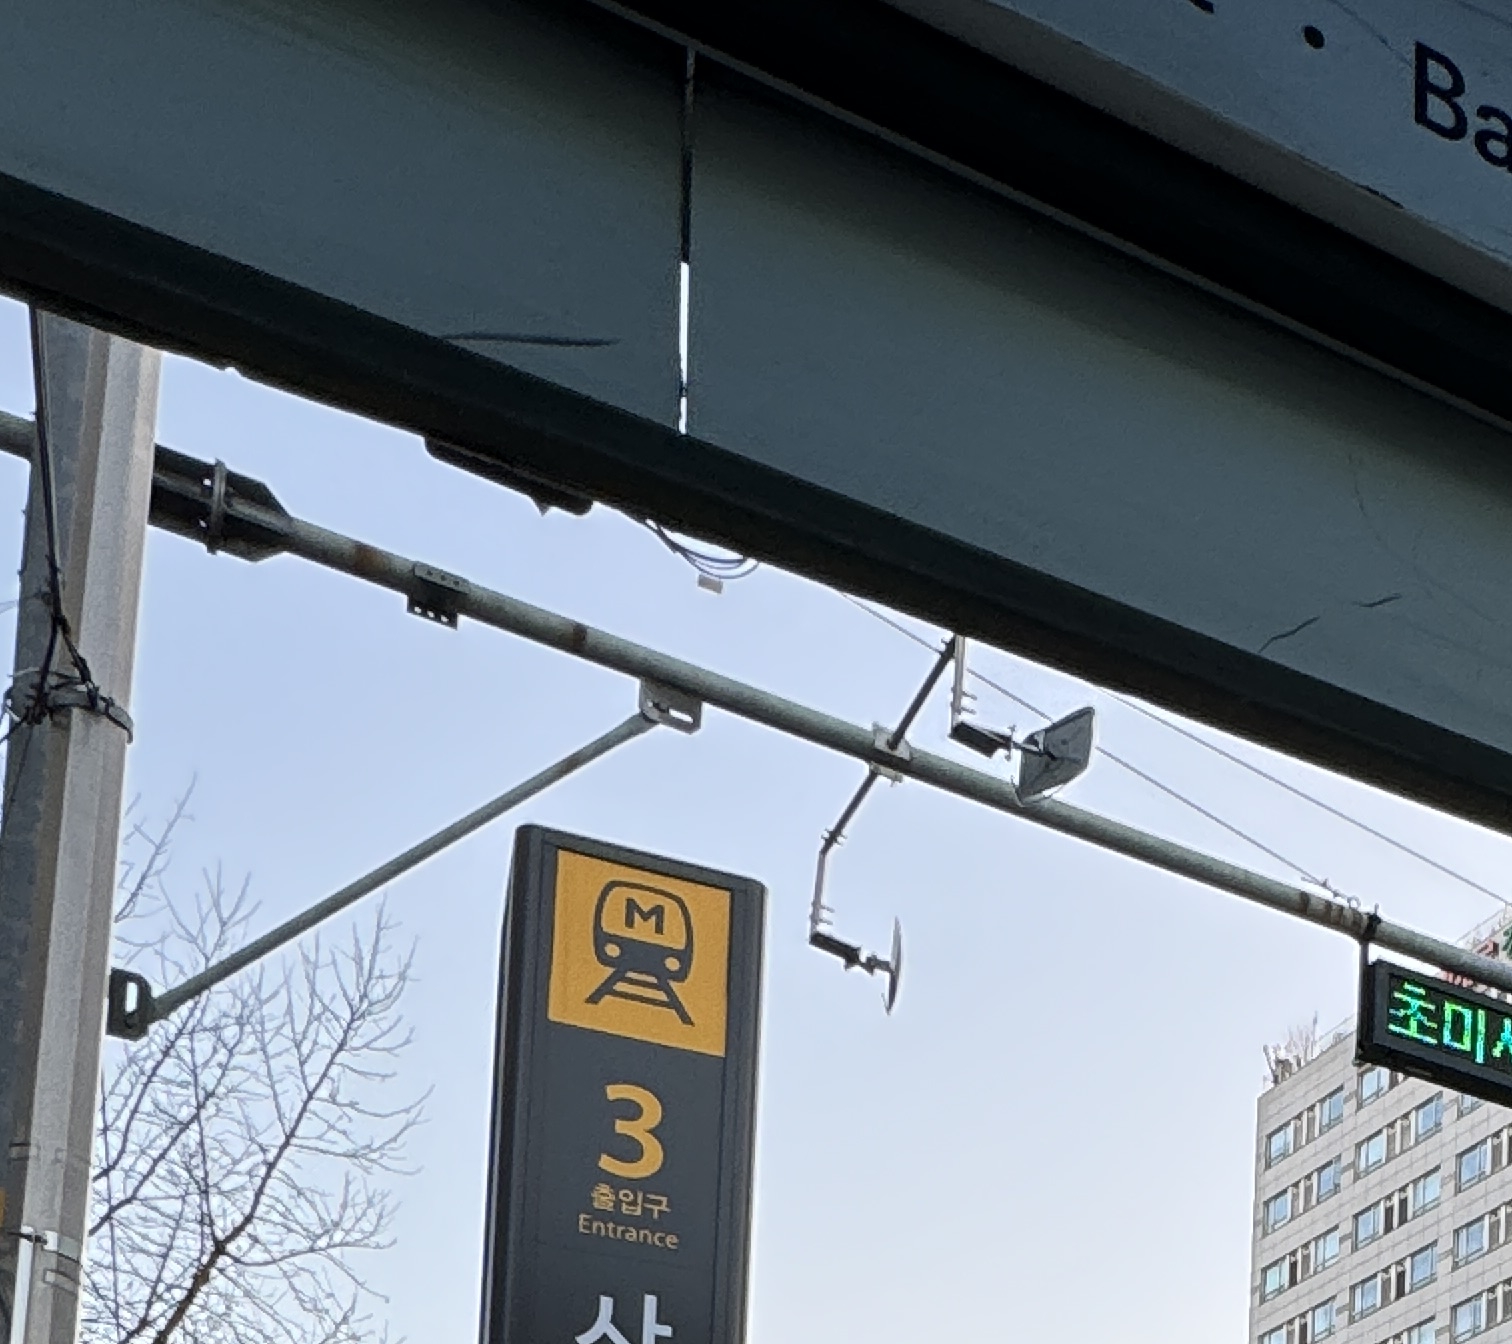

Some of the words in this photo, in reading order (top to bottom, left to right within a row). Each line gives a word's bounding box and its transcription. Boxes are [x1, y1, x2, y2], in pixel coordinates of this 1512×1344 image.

[598, 1082, 665, 1180] 3
[590, 1183, 672, 1221] 출입구
[578, 1213, 680, 1250] Entrance
